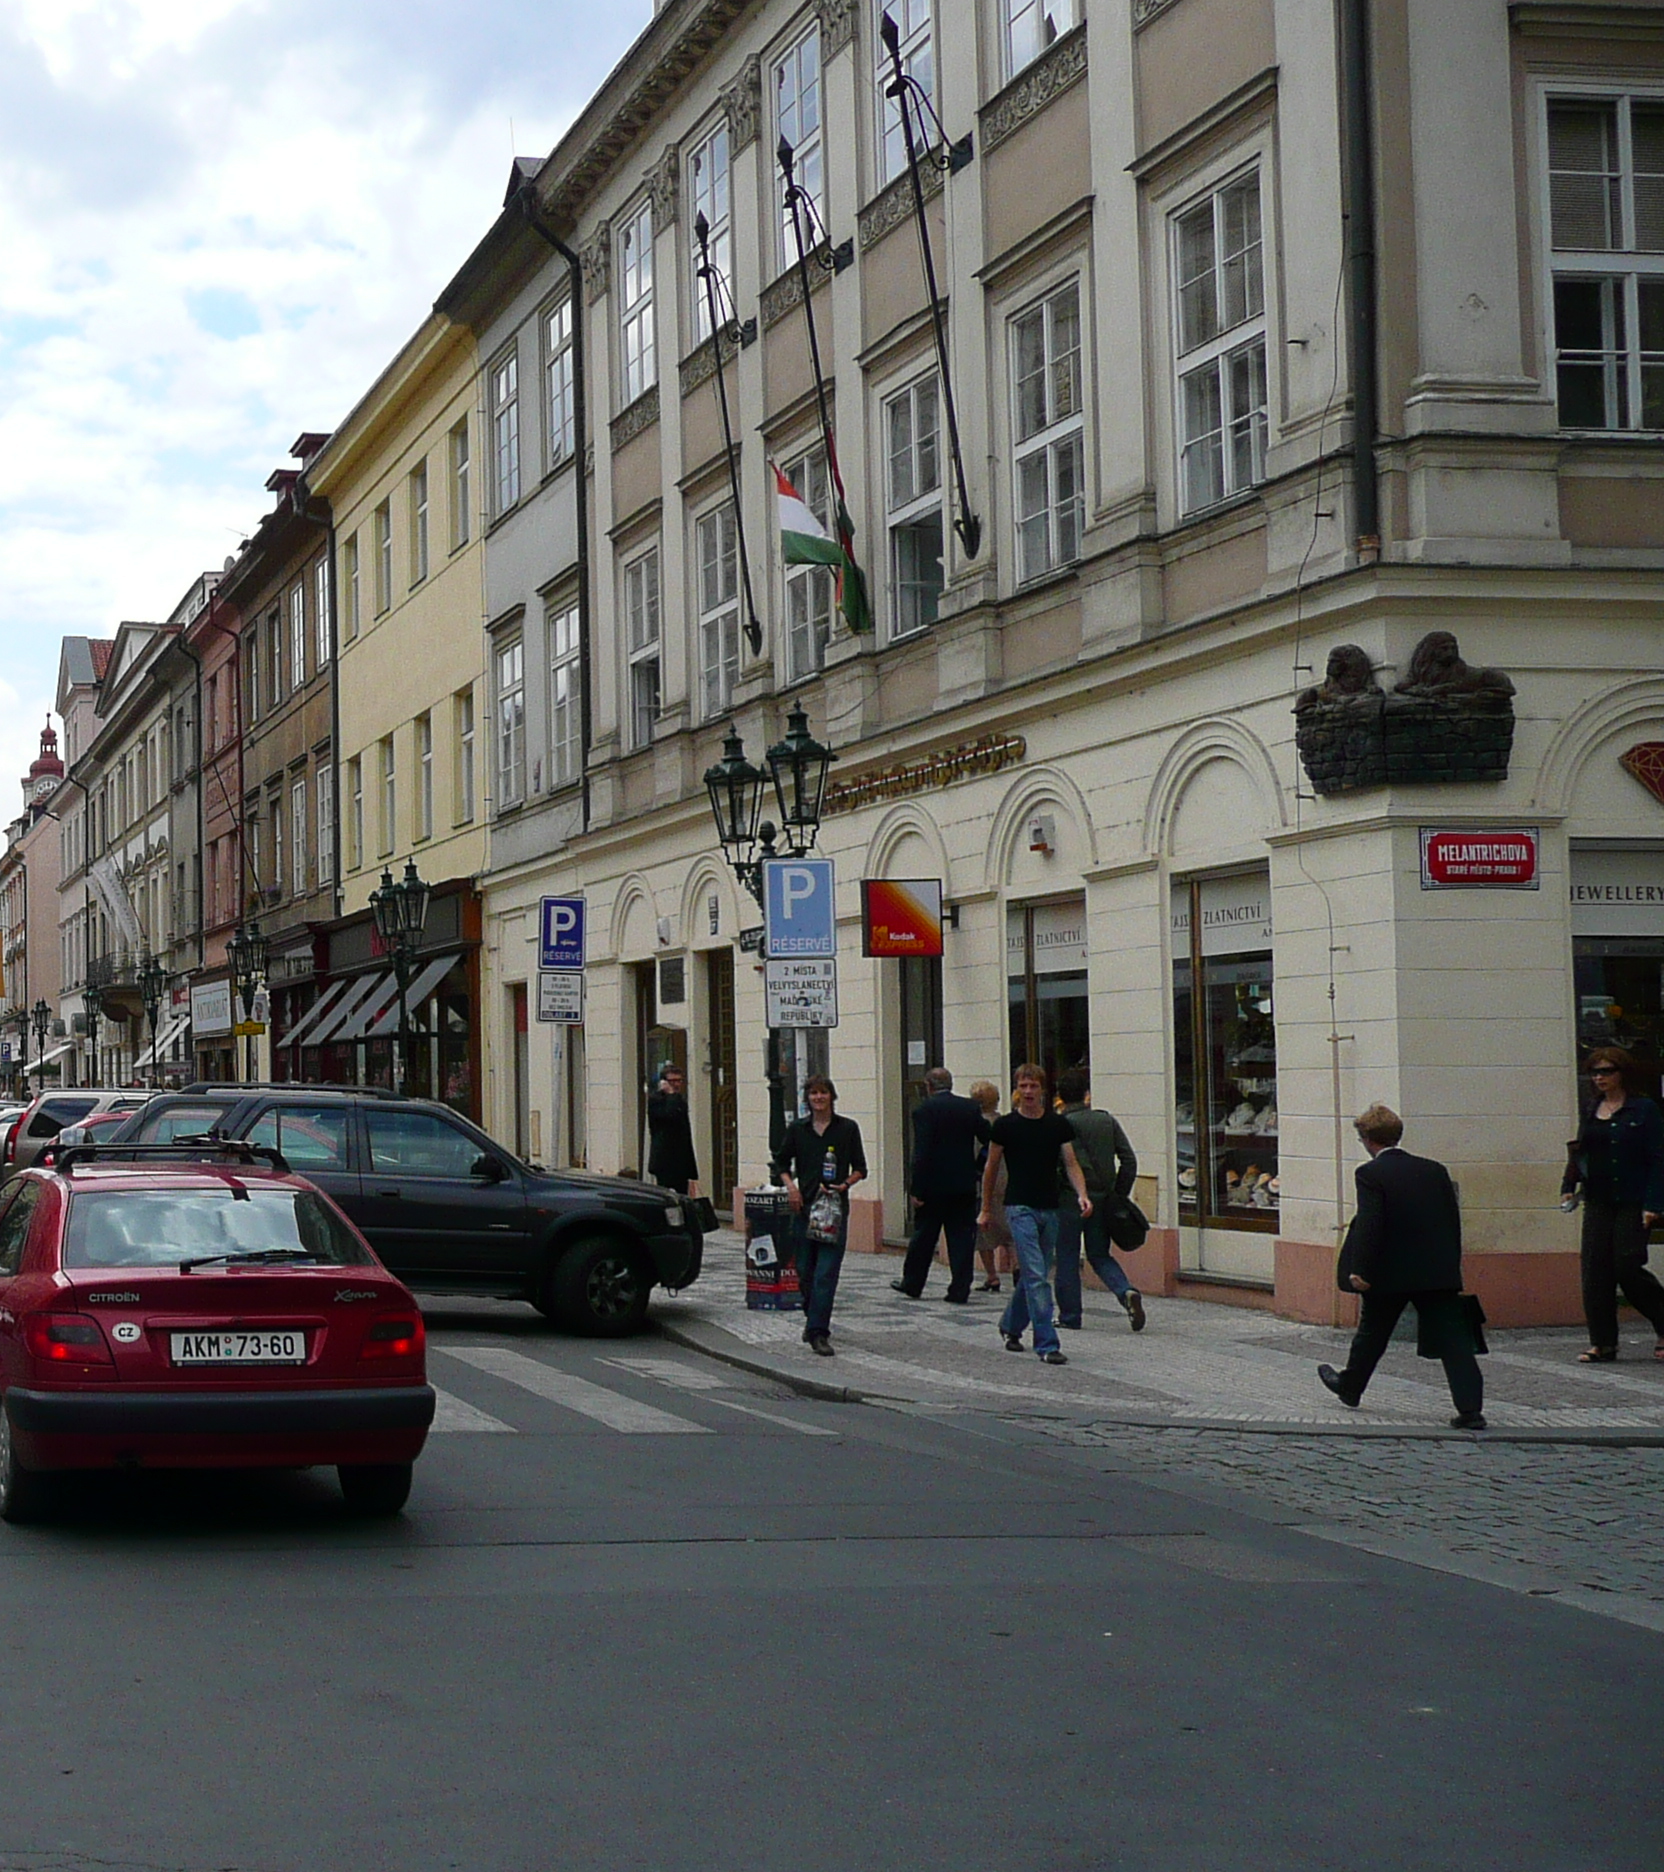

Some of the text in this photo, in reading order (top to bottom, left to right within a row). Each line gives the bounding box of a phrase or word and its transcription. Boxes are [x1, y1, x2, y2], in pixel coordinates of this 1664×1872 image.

[1438, 844, 1528, 861] MELANTRICHOVA
[1446, 864, 1468, 875] STARÉ
[783, 868, 816, 919] P
[1203, 901, 1262, 925] ZLATNICTVÍ
[550, 906, 576, 946] P
[889, 932, 915, 940] Kodak
[1036, 926, 1082, 945] ZLATNICTVÍ
[772, 935, 830, 951] RÉSERVÉ
[543, 950, 582, 960] RÉSERVÉ
[784, 965, 817, 976] 2 MÍSTA
[746, 1269, 775, 1279] VANNI
[89, 1292, 140, 1302] CITROËN
[333, 1289, 378, 1302] Xsara
[117, 1327, 134, 1338] CZ
[182, 1335, 295, 1358] AKM 73-60
